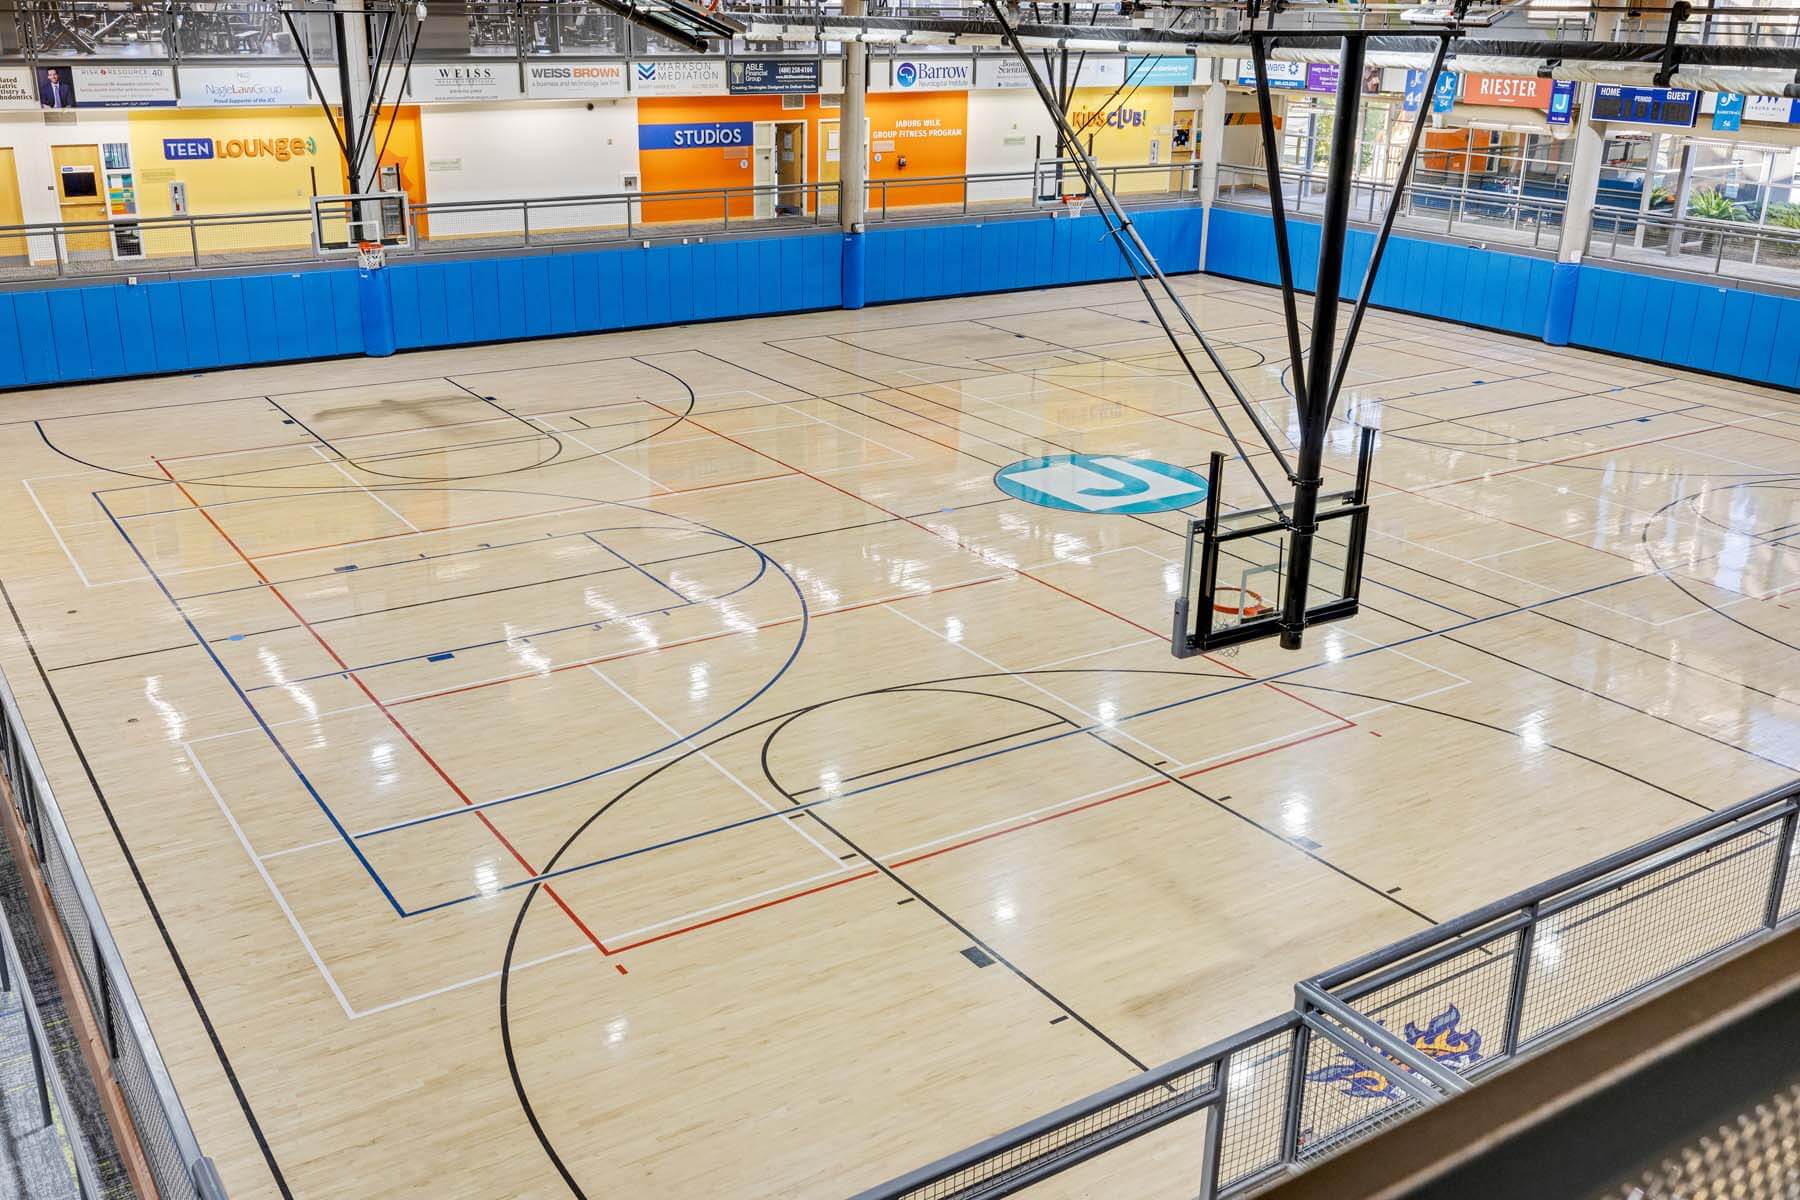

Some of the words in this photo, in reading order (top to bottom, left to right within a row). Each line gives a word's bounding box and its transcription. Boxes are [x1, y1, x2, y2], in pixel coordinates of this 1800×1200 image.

[658, 62, 711, 71] MARKSON
[919, 63, 968, 79] Barrow
[439, 68, 491, 78] WEISS
[531, 68, 571, 78] WEISS
[573, 67, 619, 78] BROWN
[658, 71, 719, 80] MEDIATION
[1481, 78, 1537, 97] RIESTER
[1601, 87, 1621, 97] HOME
[1666, 91, 1691, 101] GUEST
[896, 119, 921, 128] JABURG
[924, 119, 941, 127] WILK
[873, 130, 897, 139] GROUP
[899, 129, 927, 138] FITNESS
[928, 128, 962, 137] PROGRAM
[167, 143, 209, 156] TEEN
